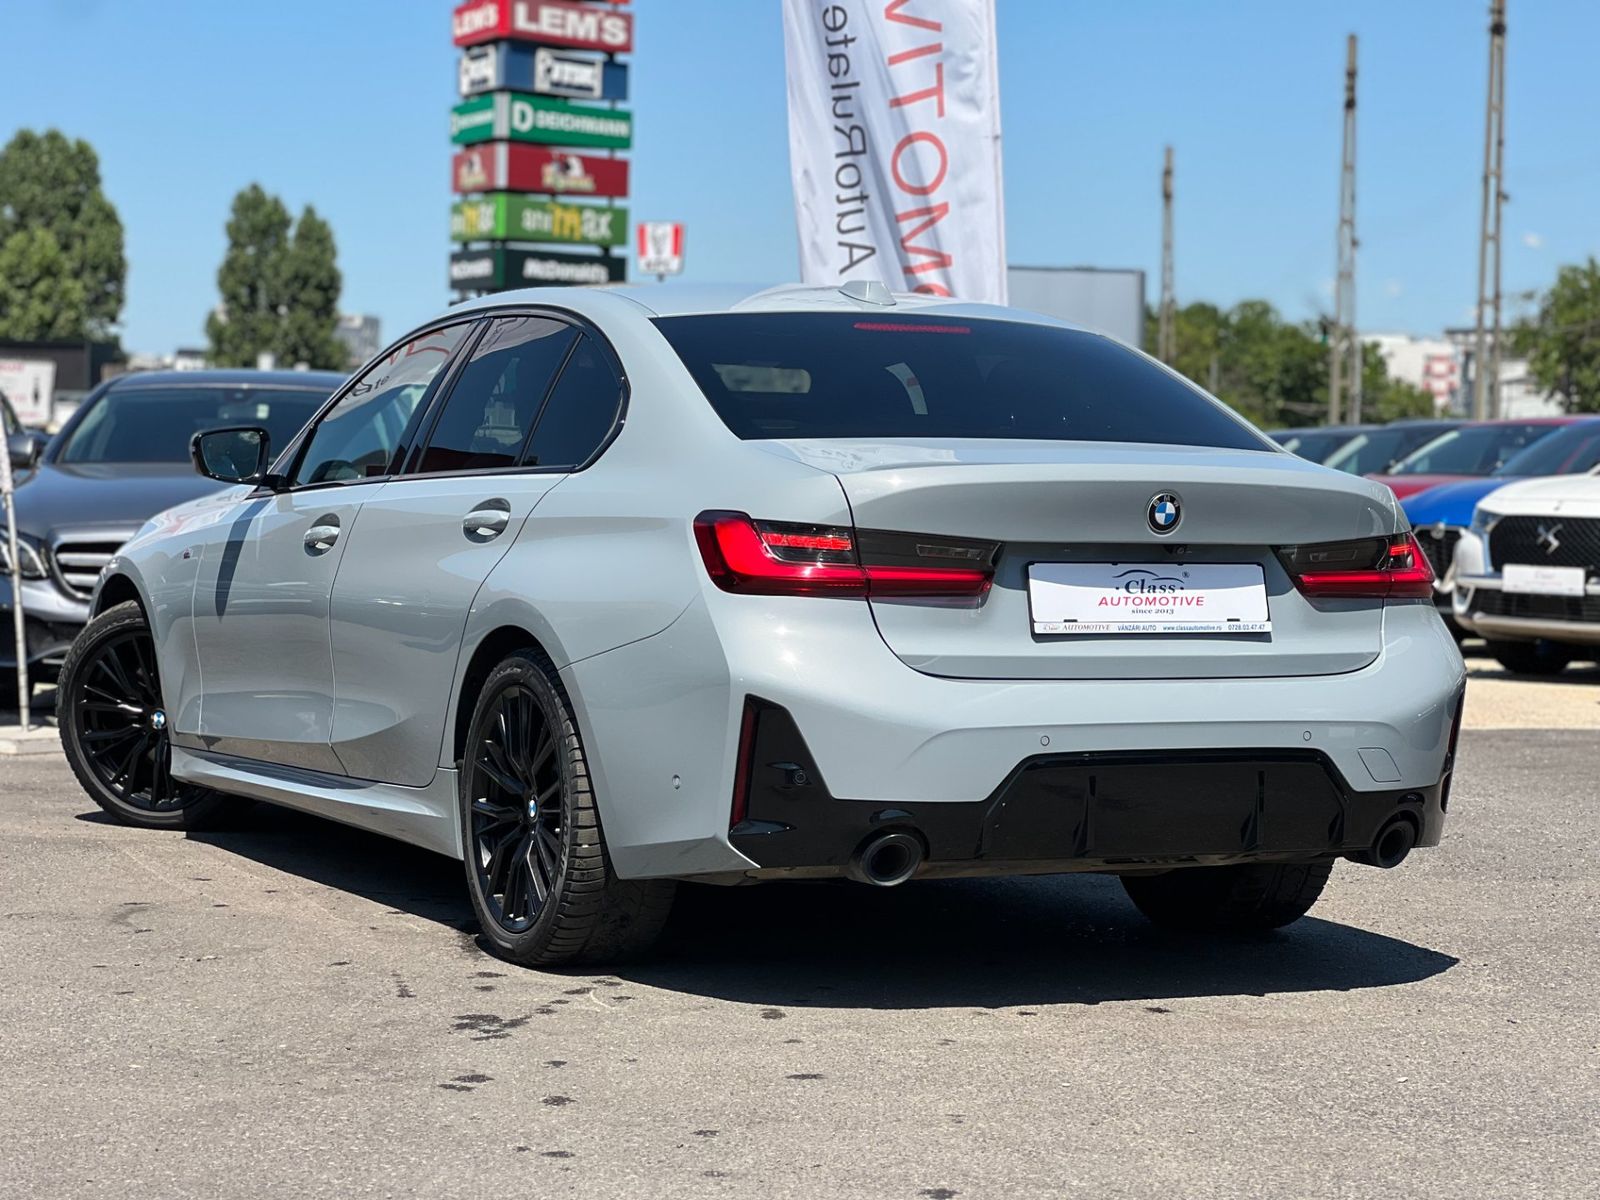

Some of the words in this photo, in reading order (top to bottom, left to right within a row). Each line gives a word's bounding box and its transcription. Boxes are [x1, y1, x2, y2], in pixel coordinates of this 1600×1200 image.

[514, 2, 629, 46] LEM'S
[1124, 579, 1176, 594] Class
[1098, 596, 1205, 606] AUTOMOTIVE
